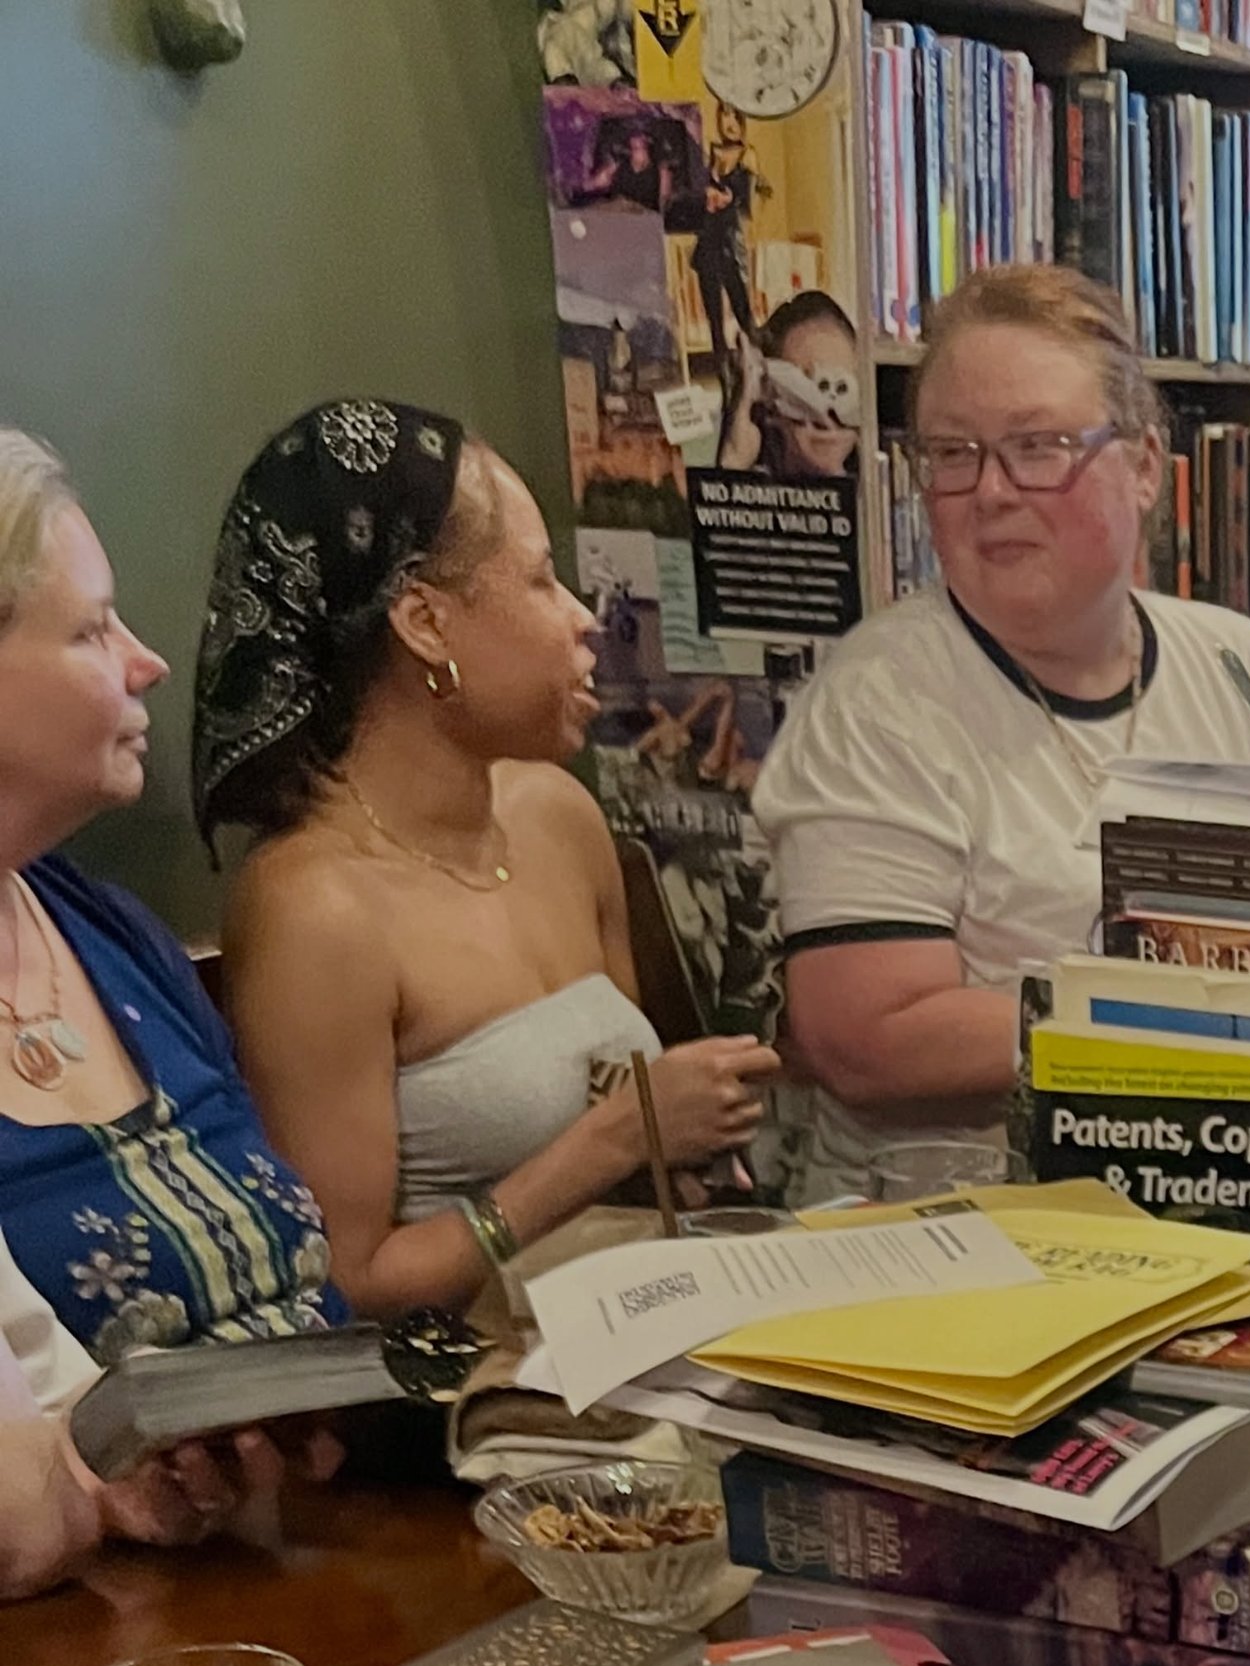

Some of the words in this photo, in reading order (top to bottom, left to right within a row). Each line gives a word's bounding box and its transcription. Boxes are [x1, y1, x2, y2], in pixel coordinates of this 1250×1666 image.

[701, 482, 729, 503] NO
[732, 484, 840, 511] ADMITTANCE
[696, 506, 774, 531] WITHOUT
[777, 513, 828, 534] VALID
[832, 516, 851, 536] ID
[1052, 1108, 1193, 1157] Patents,
[1105, 1164, 1131, 1196] &
